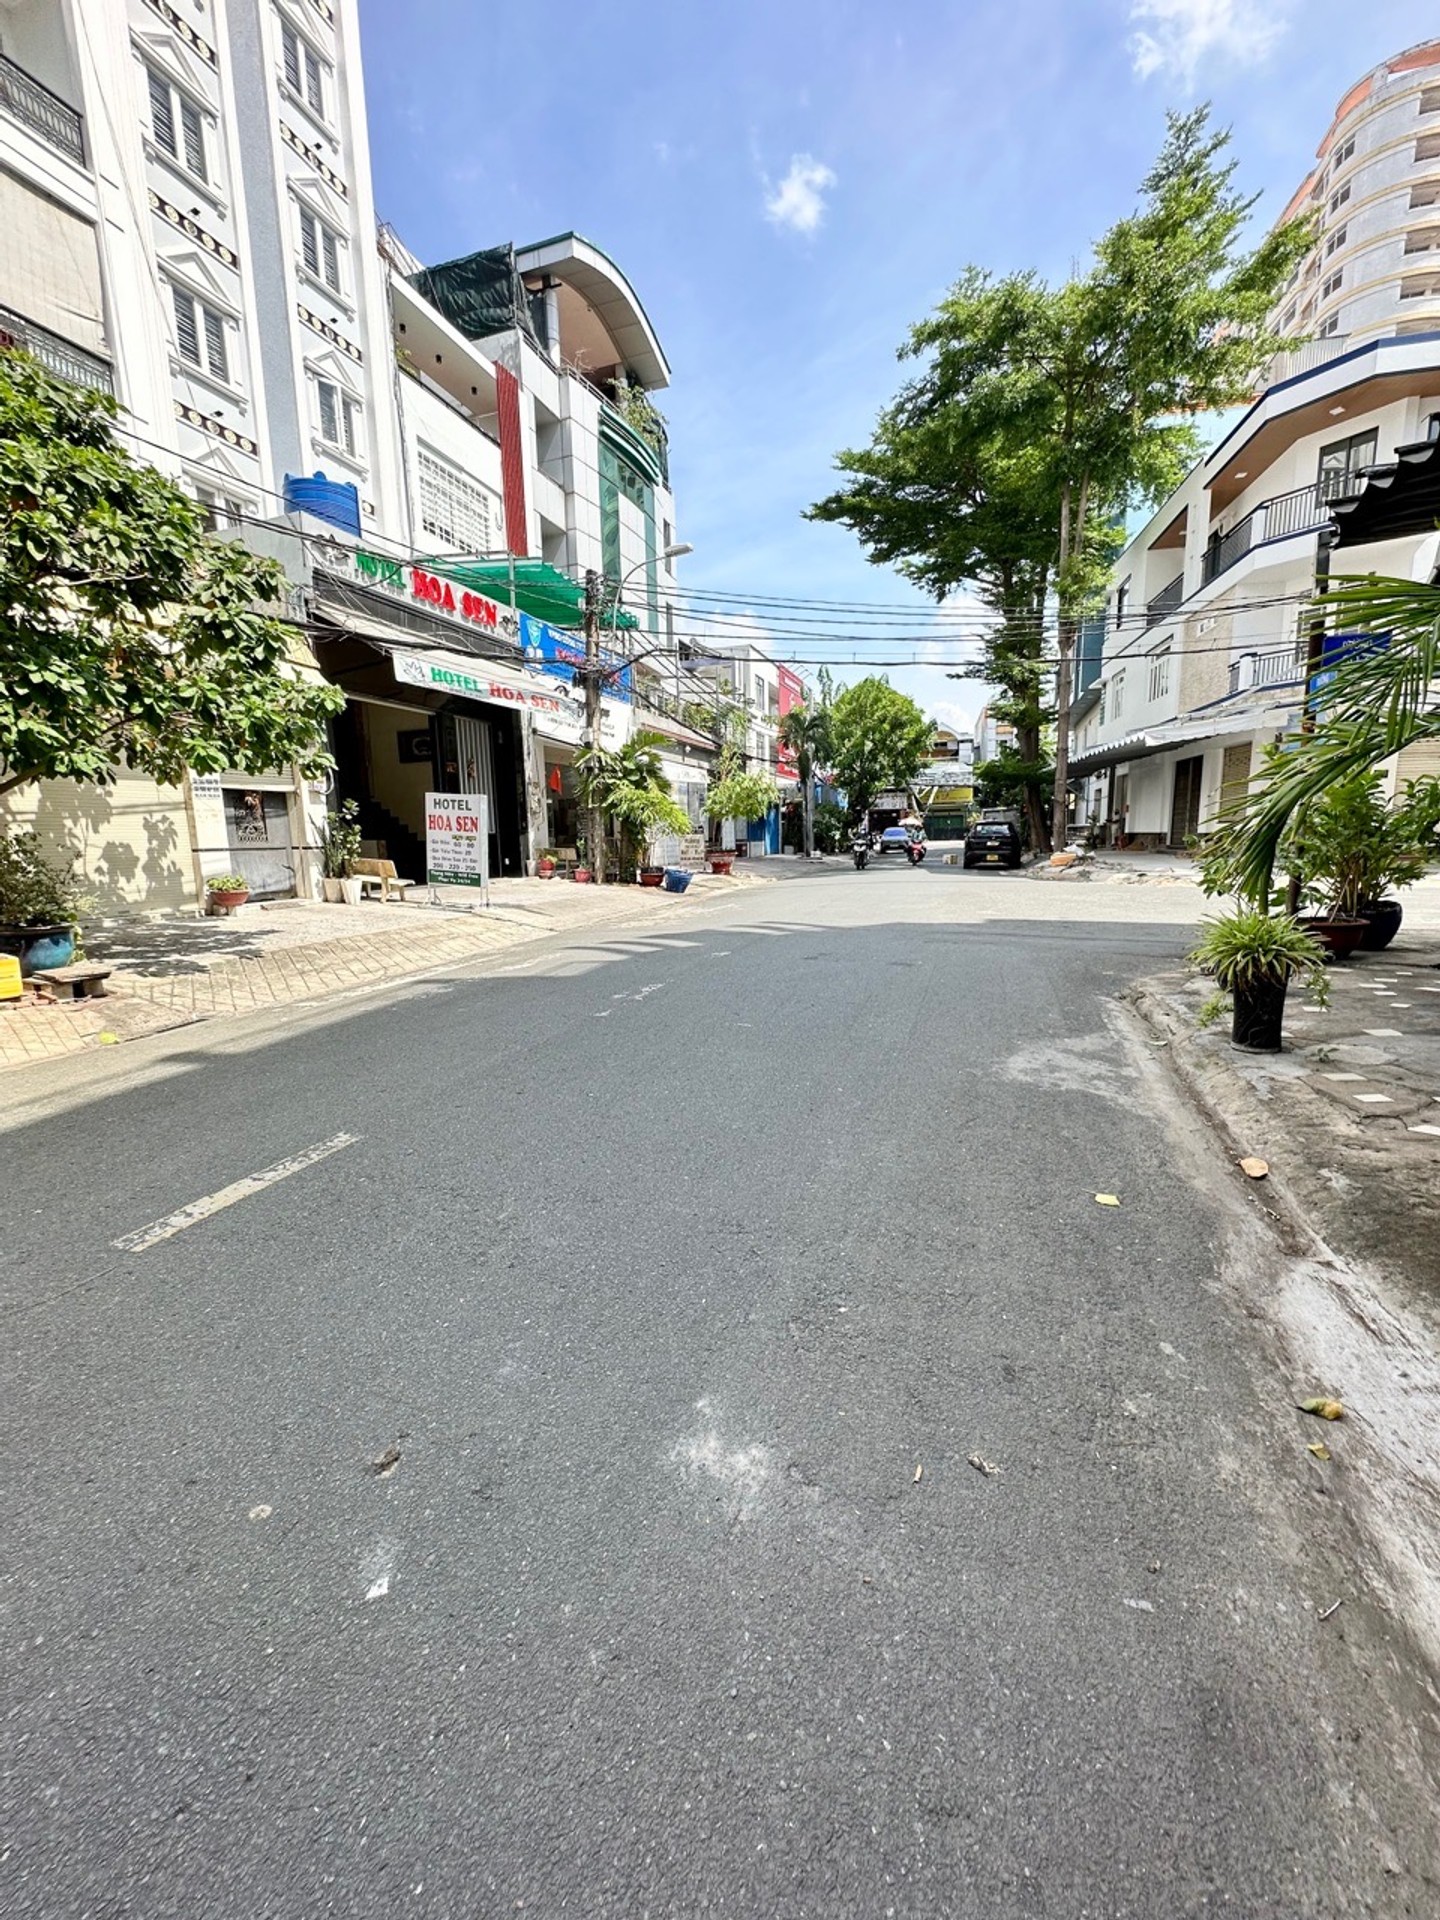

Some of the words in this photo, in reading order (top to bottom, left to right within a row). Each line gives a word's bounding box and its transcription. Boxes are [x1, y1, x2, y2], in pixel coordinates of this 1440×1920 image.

[412, 566, 456, 611] HOA
[462, 591, 497, 627] SEN
[430, 667, 483, 693] HOTEL
[488, 681, 527, 705] HOA
[531, 695, 561, 712] SEN
[433, 798, 472, 811] HOTEL
[428, 814, 452, 831] HOA
[456, 816, 478, 833] SEN
